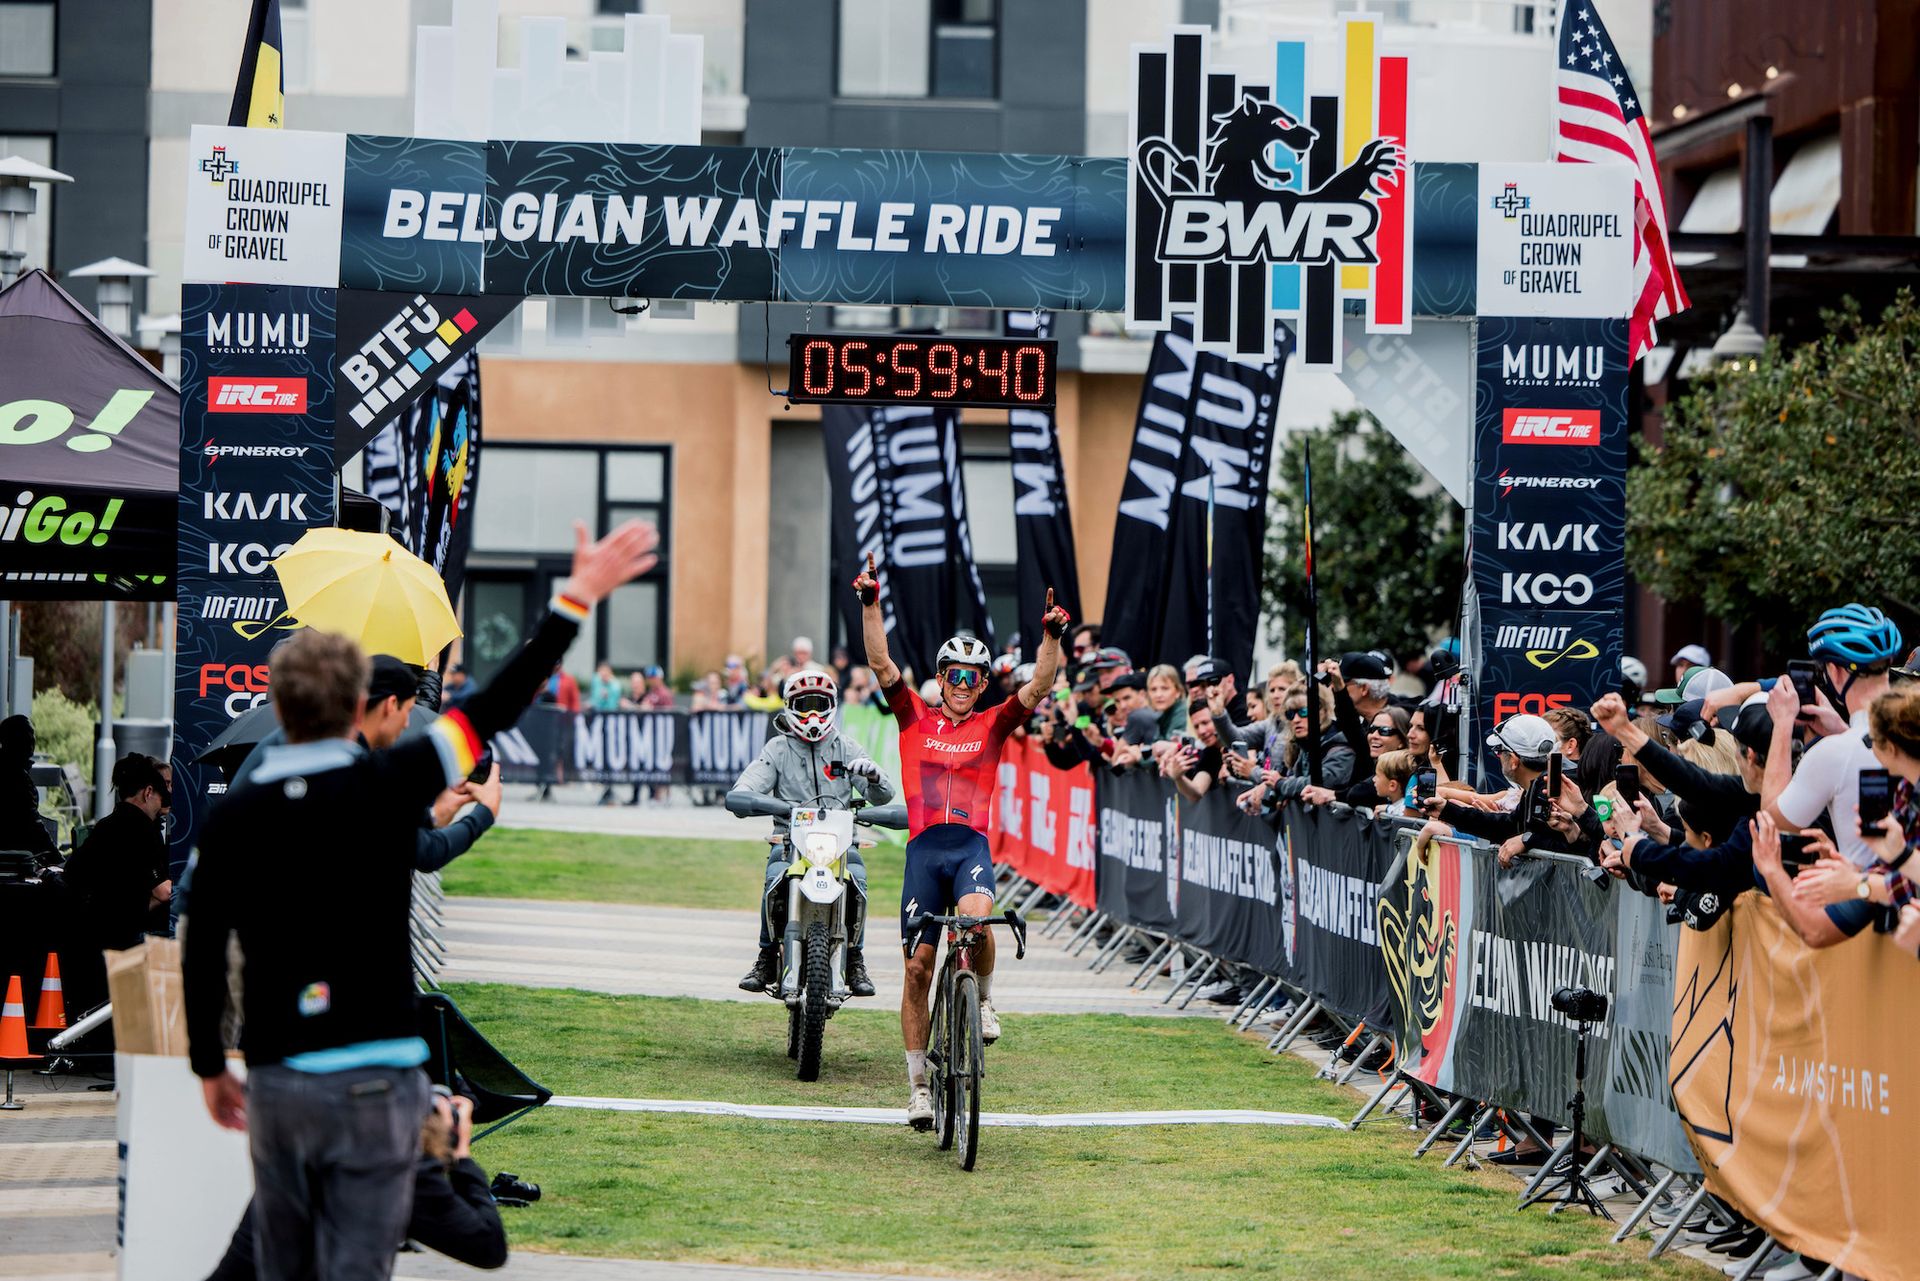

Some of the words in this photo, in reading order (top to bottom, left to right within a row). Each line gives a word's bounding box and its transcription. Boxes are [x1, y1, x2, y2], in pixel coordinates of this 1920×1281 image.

[228, 178, 331, 207] QUADRUPEL
[226, 207, 289, 233] CROWN
[382, 188, 649, 245] BELGIAN
[663, 195, 916, 253] WAFFLE
[924, 203, 1063, 257] RIDE
[1164, 199, 1374, 259] BWR
[1520, 214, 1623, 238] QUADRUPEL
[208, 234, 222, 250] OF
[225, 235, 288, 262] GRAVEL
[1520, 242, 1582, 267] CROWN
[1503, 270, 1517, 285] OF
[1519, 270, 1582, 294] GRAVEL
[207, 312, 310, 348] MUMU
[210, 347, 255, 355] CYCLING
[1502, 344, 1604, 380] MUMU
[803, 340, 1046, 401] 05:59:40
[1554, 380, 1601, 388] APPAREL
[273, 393, 299, 406] TIRE
[1567, 425, 1593, 438] TIRE
[203, 443, 310, 460] SPINERGY
[886, 405, 947, 568] UMU
[1498, 474, 1603, 491] SPINERGY
[204, 492, 308, 521] KASK
[1498, 522, 1600, 552] KASK
[200, 664, 271, 698] FAS
[575, 714, 675, 771] MUMU
[923, 737, 983, 753] SPECIALIZED
